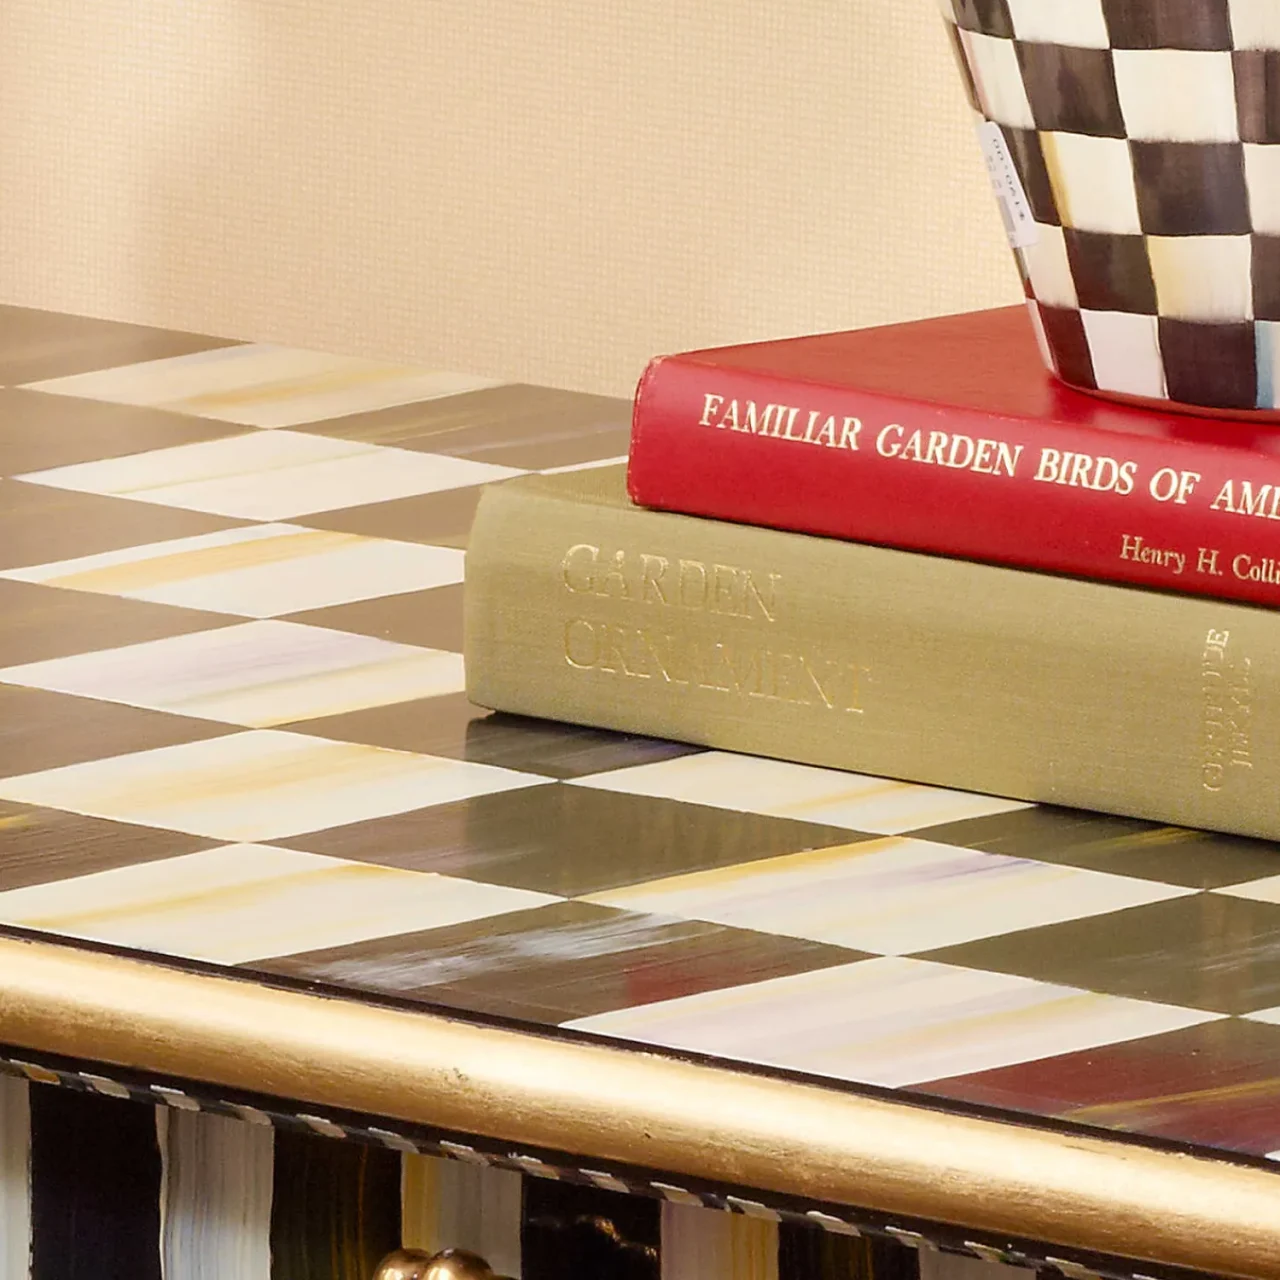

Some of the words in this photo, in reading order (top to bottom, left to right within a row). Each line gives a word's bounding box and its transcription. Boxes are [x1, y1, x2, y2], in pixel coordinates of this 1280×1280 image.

[699, 394, 862, 450] FAMILIAR
[876, 424, 1024, 477] GARDEN
[1034, 448, 1138, 494] BIRDS
[1150, 468, 1201, 504] OF
[562, 544, 782, 622] GARDEN
[1120, 534, 1185, 574] Henry
[1197, 548, 1223, 575] H.
